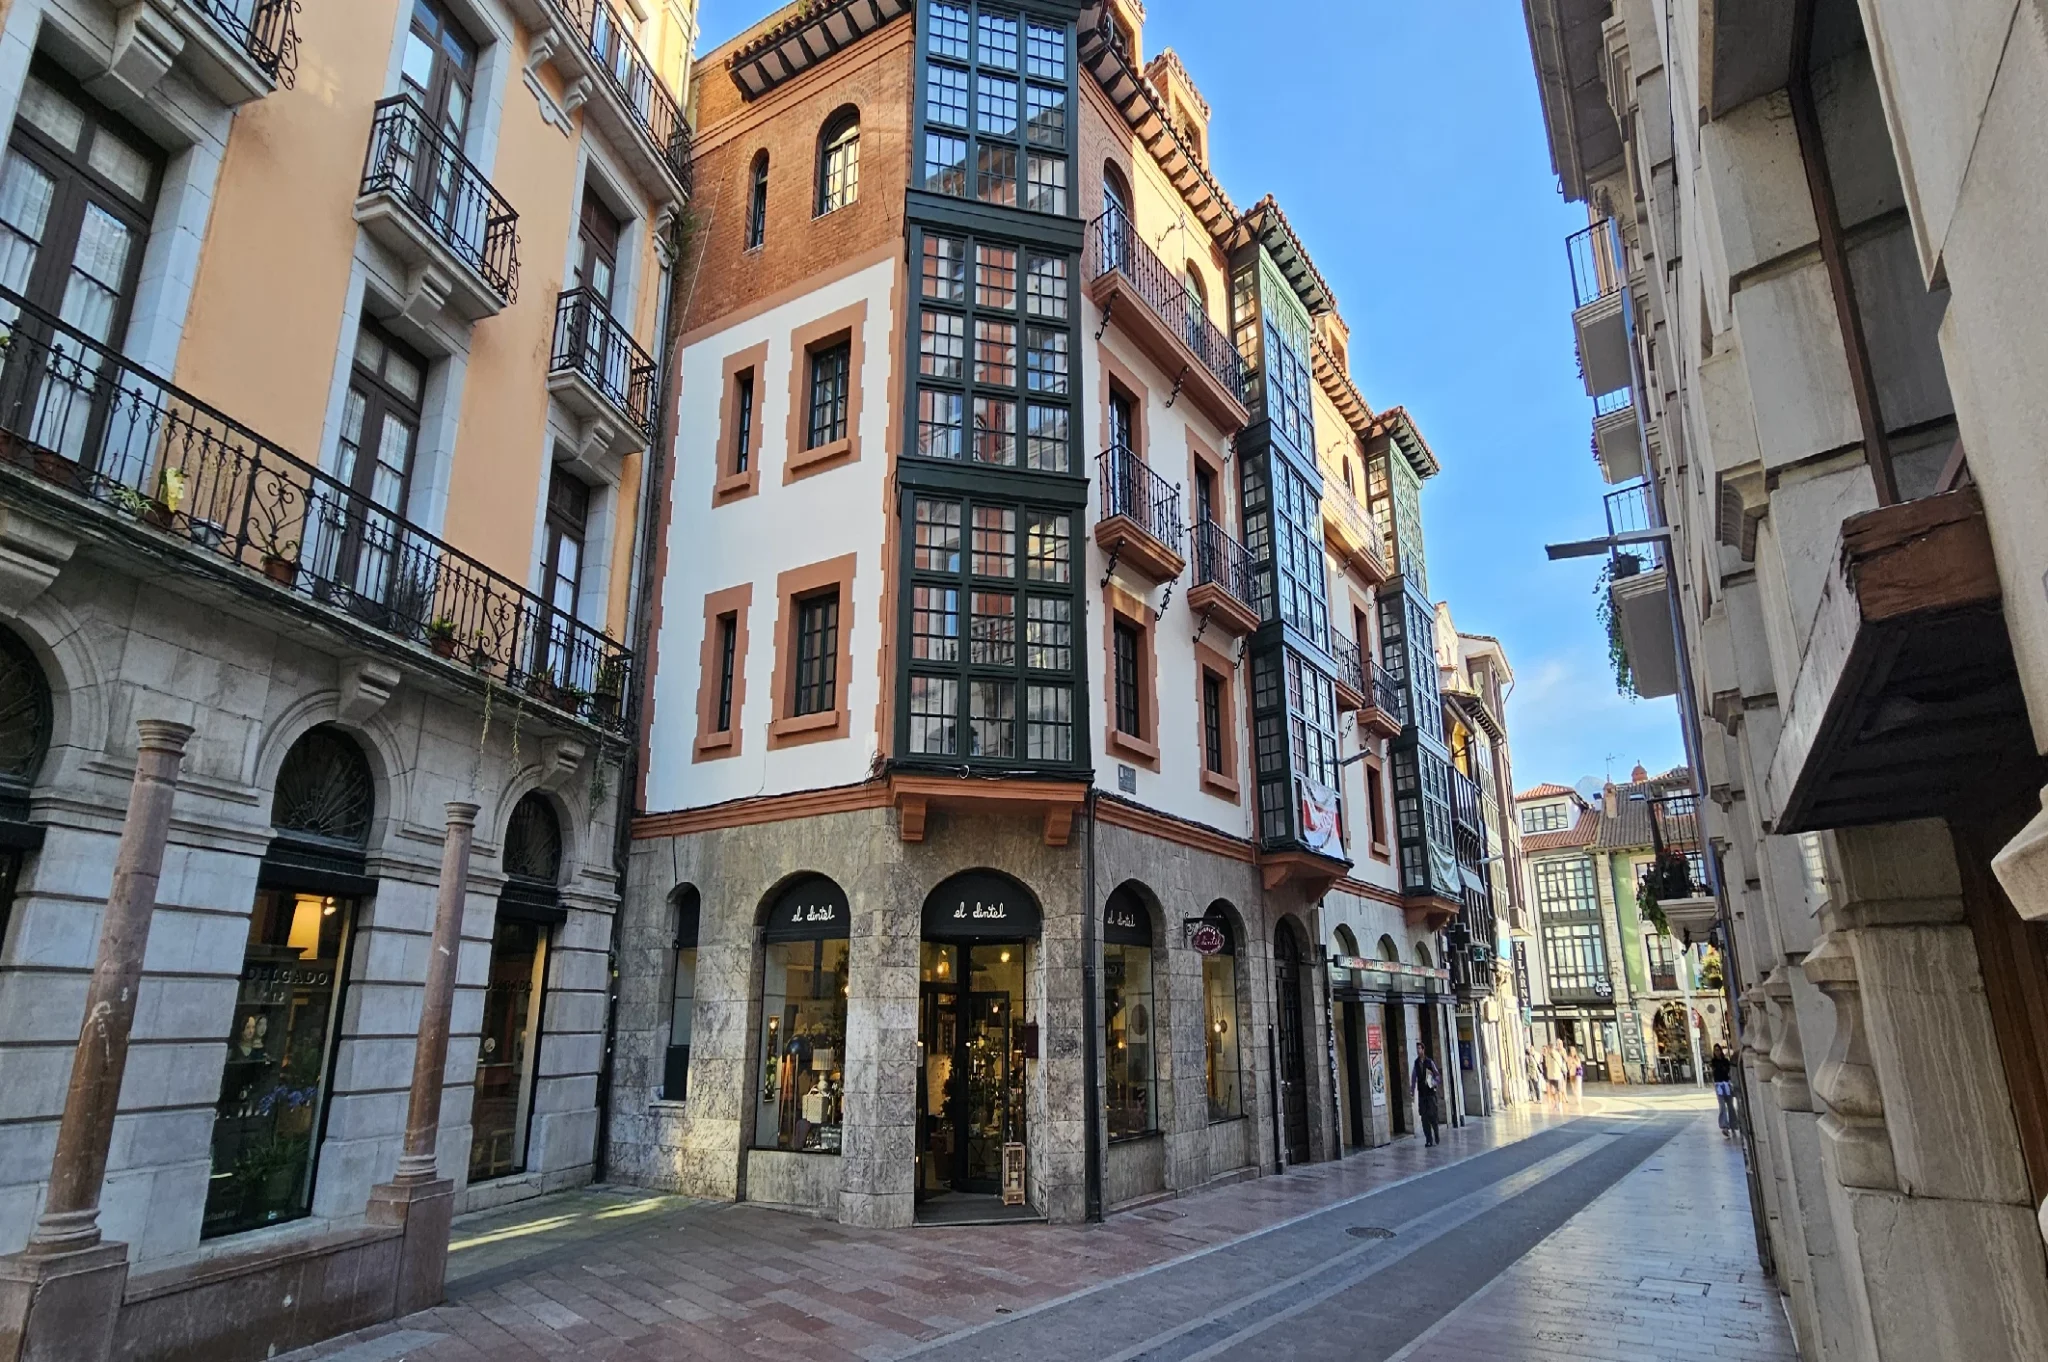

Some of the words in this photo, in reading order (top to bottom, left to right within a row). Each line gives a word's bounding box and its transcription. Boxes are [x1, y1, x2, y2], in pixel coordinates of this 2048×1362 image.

[791, 905, 803, 922] el
[806, 904, 836, 921] dintel
[953, 901, 967, 919] el
[972, 901, 1007, 919] dintel
[246, 966, 329, 986] DELGADO
